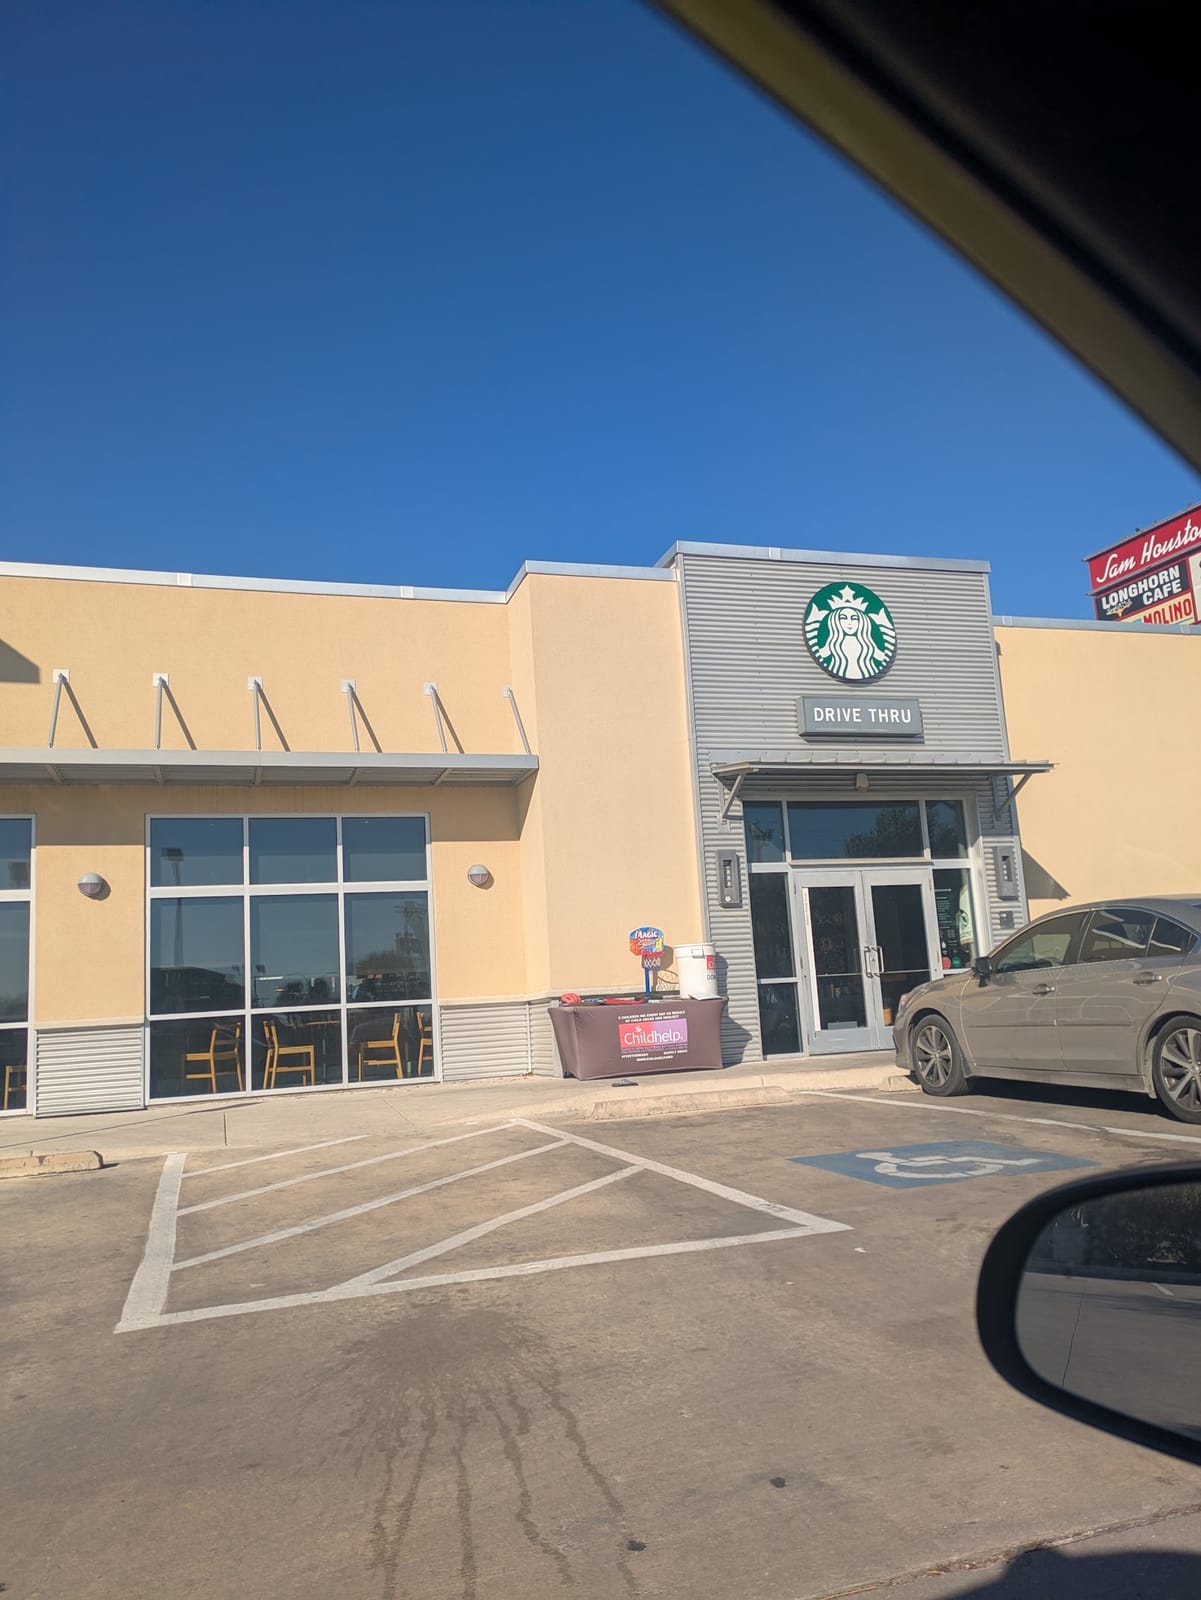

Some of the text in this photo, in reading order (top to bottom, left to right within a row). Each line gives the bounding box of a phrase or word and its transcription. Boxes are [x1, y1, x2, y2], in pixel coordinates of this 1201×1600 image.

[1096, 519, 1201, 583] Sam Housto
[1101, 565, 1180, 610] LONGHORN
[1142, 579, 1182, 606] CAFE
[1143, 598, 1192, 624] MOLINO
[814, 707, 912, 723] DRIVE THRU
[624, 1029, 681, 1046] Childhelp
